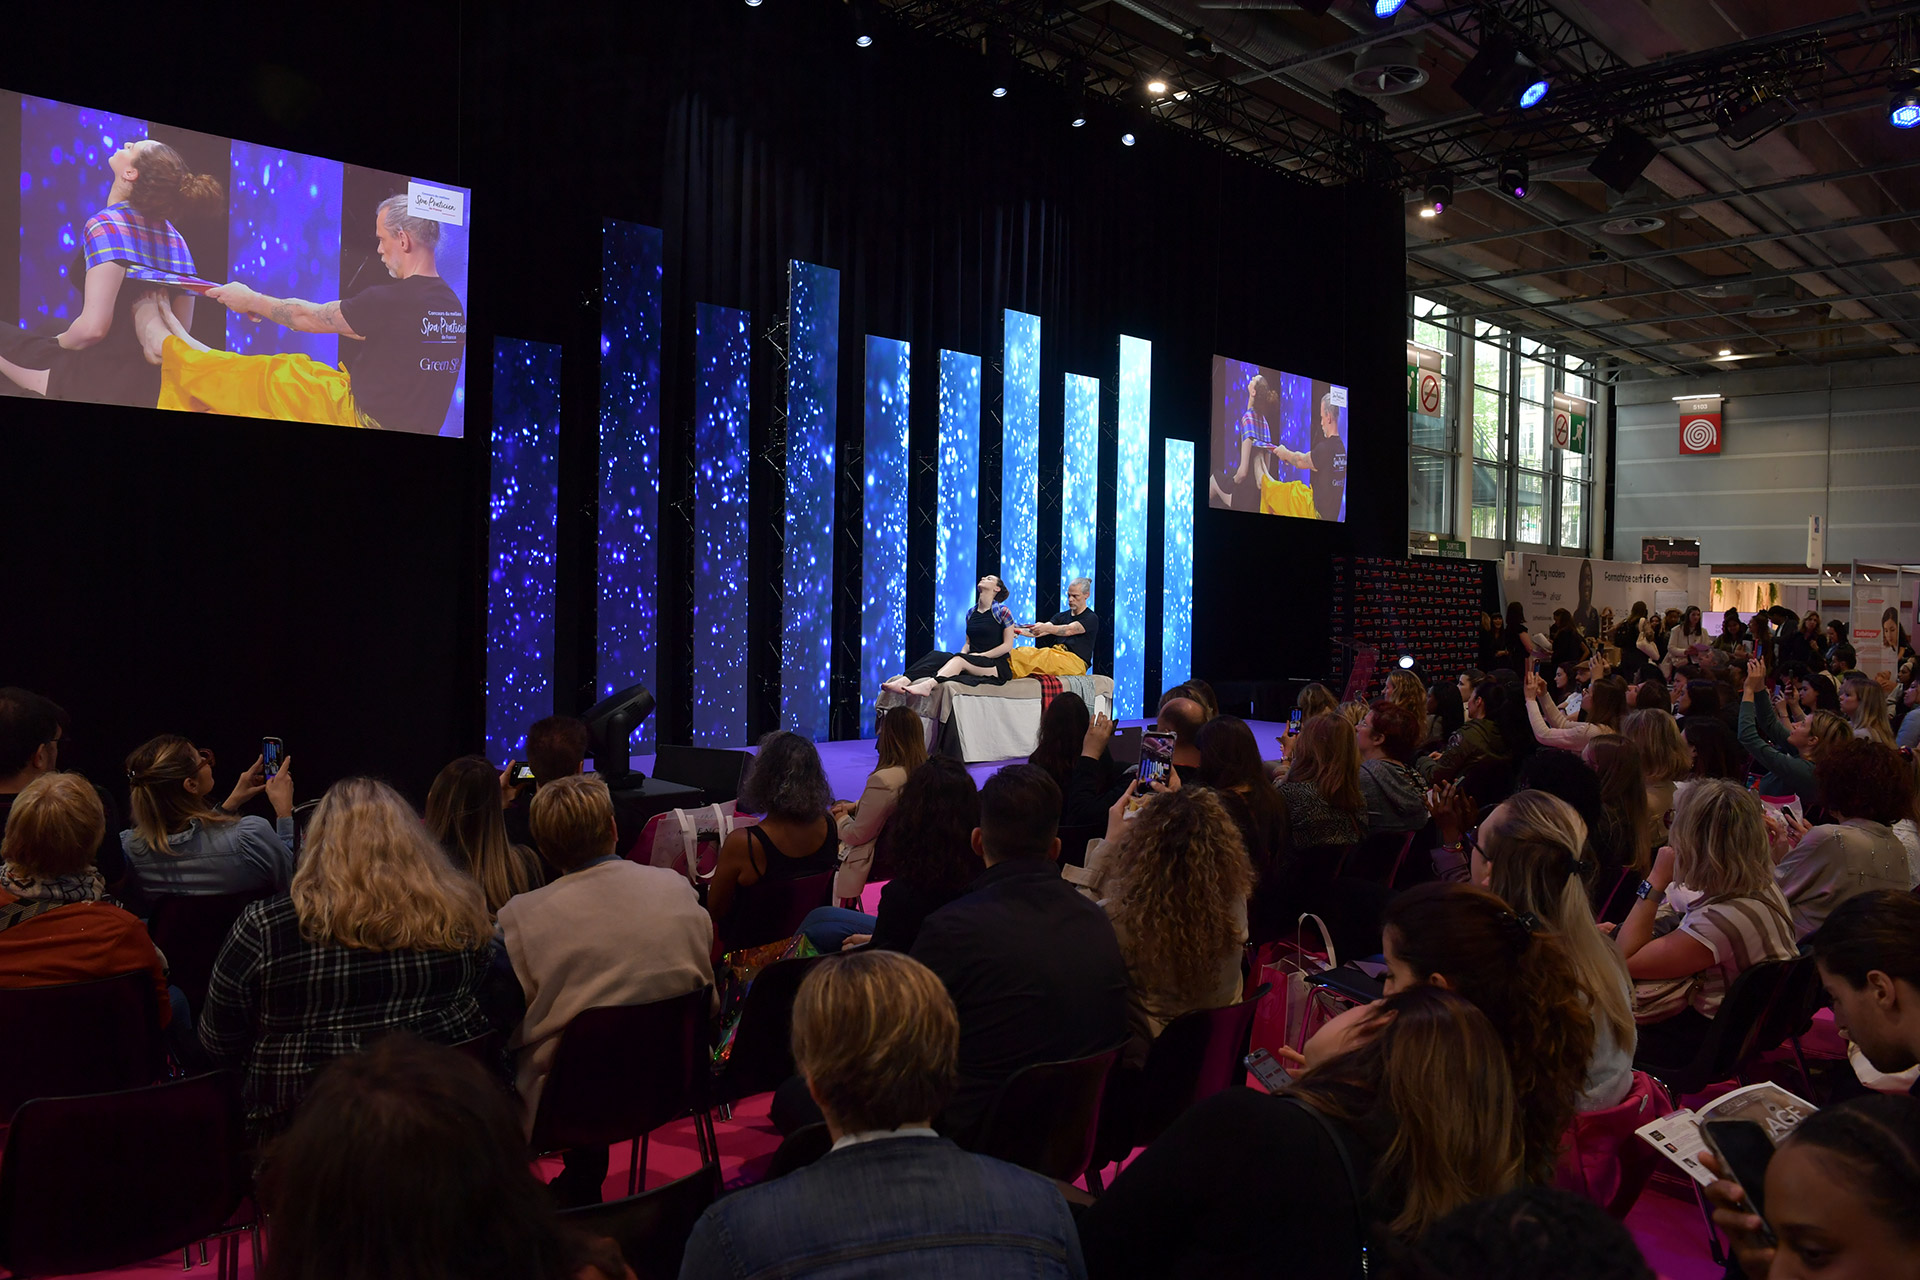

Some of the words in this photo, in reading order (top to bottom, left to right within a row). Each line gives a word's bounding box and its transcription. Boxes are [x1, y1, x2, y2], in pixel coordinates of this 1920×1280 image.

[421, 317, 440, 336] Spa
[1604, 571, 1631, 582] Formatrice
[1632, 573, 1669, 584] certifiée
